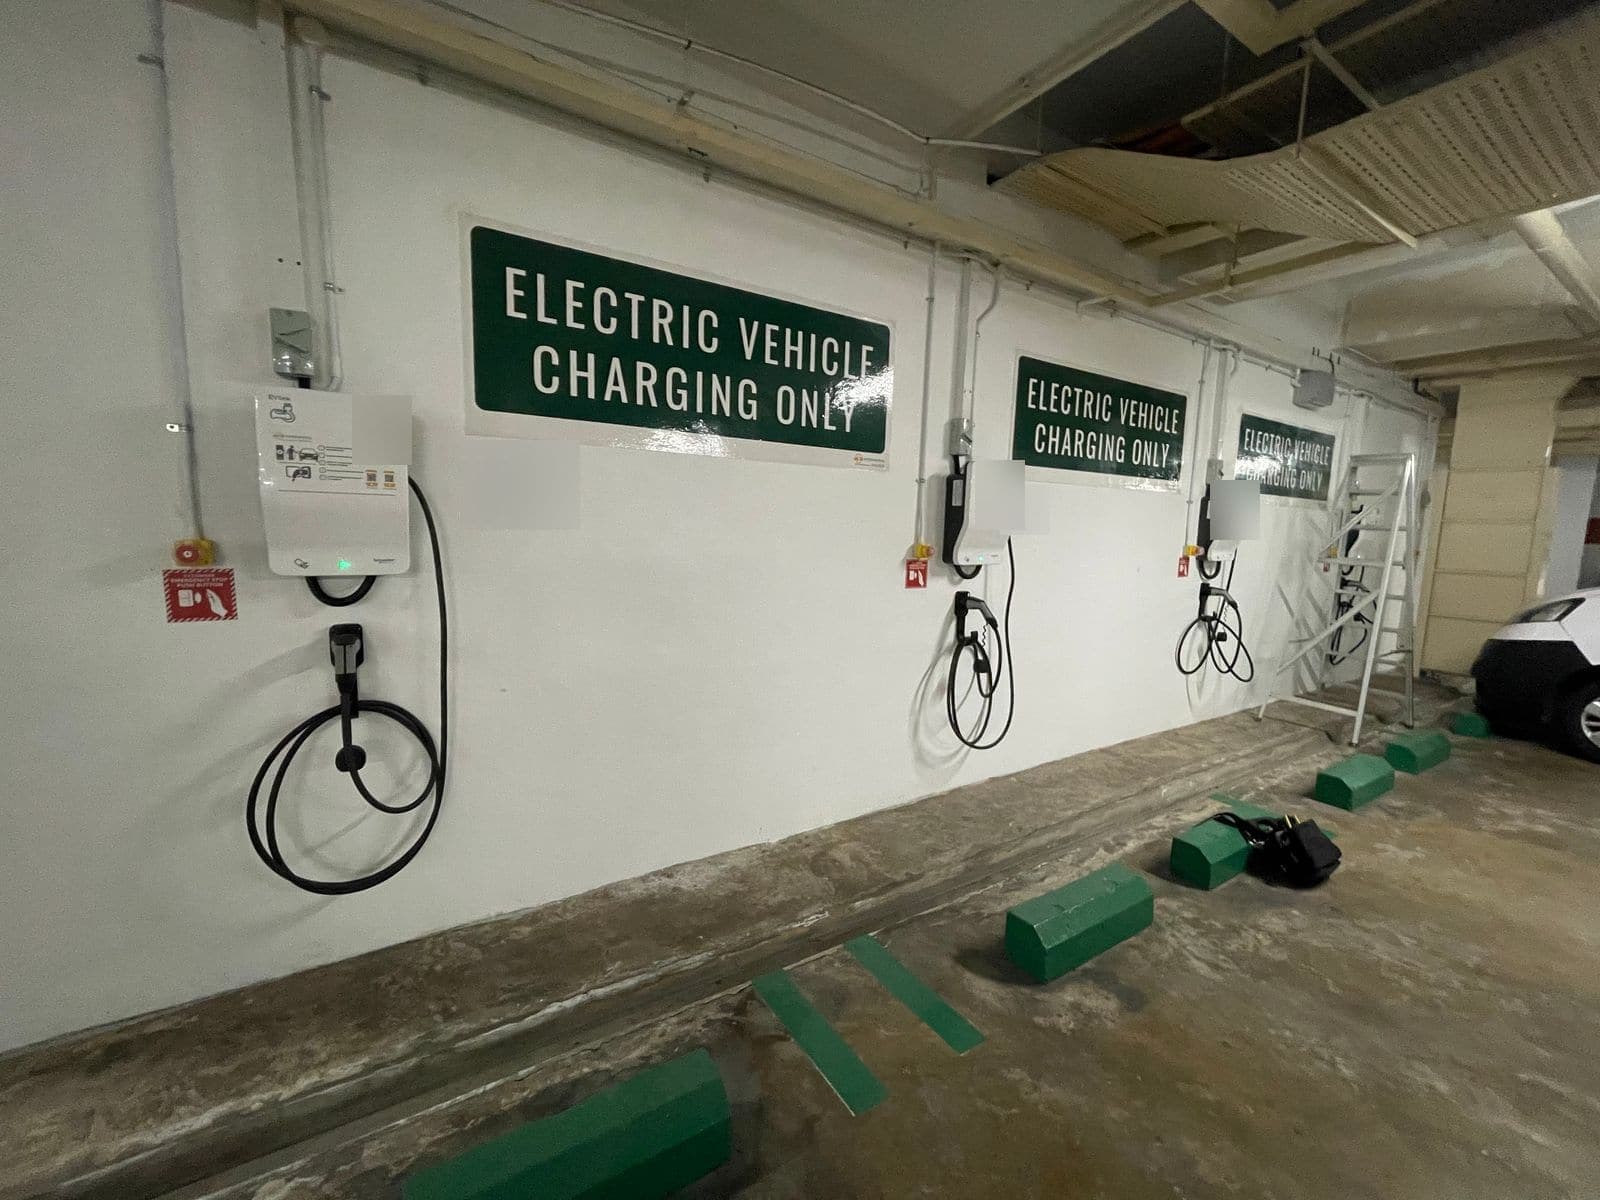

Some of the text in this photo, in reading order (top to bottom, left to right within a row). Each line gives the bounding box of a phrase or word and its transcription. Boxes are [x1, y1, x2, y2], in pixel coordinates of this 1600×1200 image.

[506, 266, 874, 379] ELECTRIC VEHICLE
[533, 344, 856, 433] CHARGING ONLY
[1027, 378, 1180, 435] ELECTRIC VEHICLE
[1034, 423, 1170, 468] CHARGING ONLY
[1244, 428, 1331, 465] ELECTRIC VEHICLE
[1300, 470, 1323, 491] ONLY
